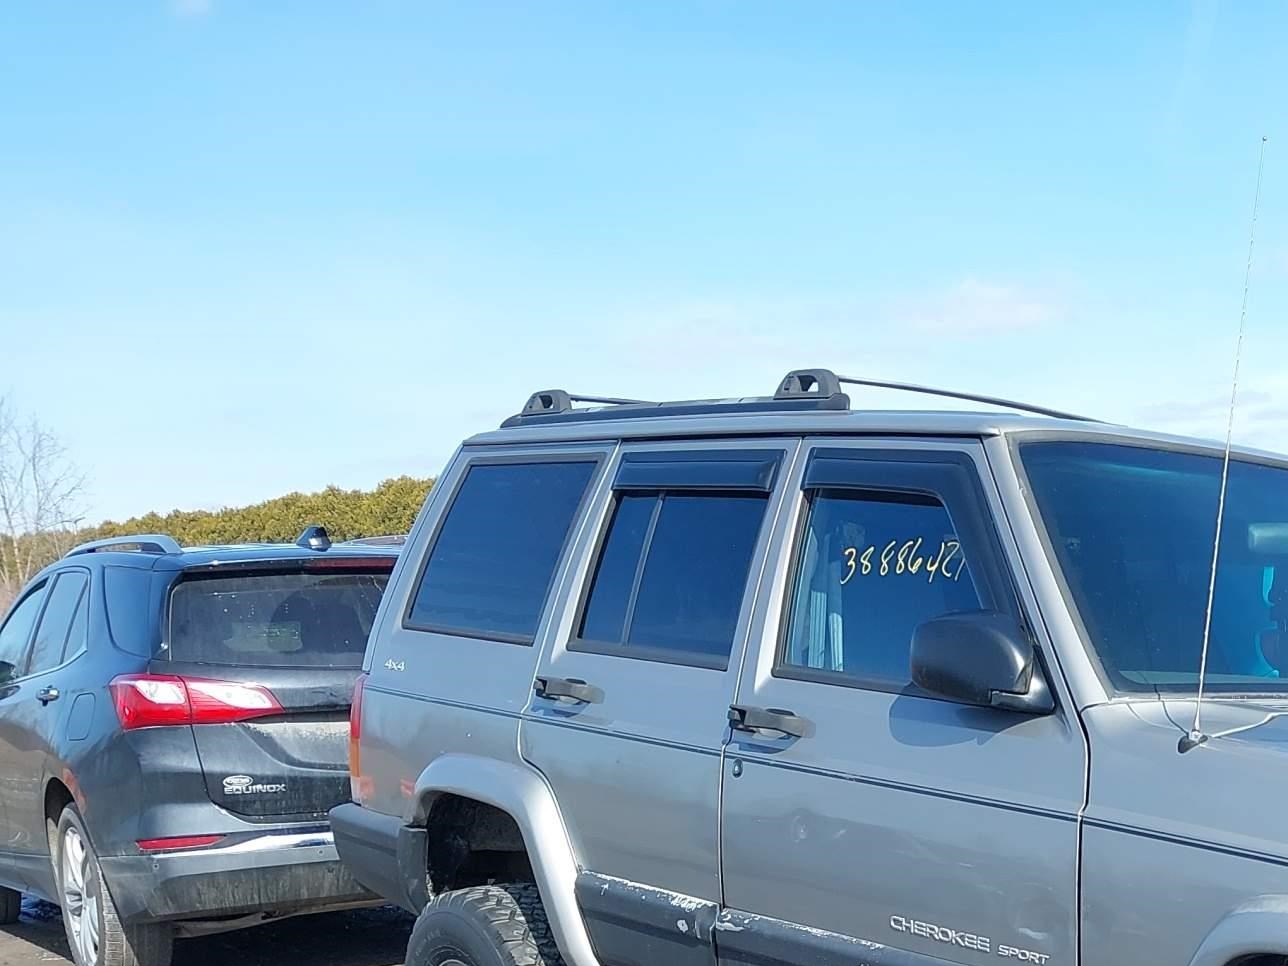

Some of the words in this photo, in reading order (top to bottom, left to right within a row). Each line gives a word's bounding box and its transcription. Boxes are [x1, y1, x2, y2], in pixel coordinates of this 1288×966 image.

[223, 783, 287, 795] EQUINOX
[889, 914, 991, 953] CHEROKEE
[996, 943, 1051, 966] SPORT
